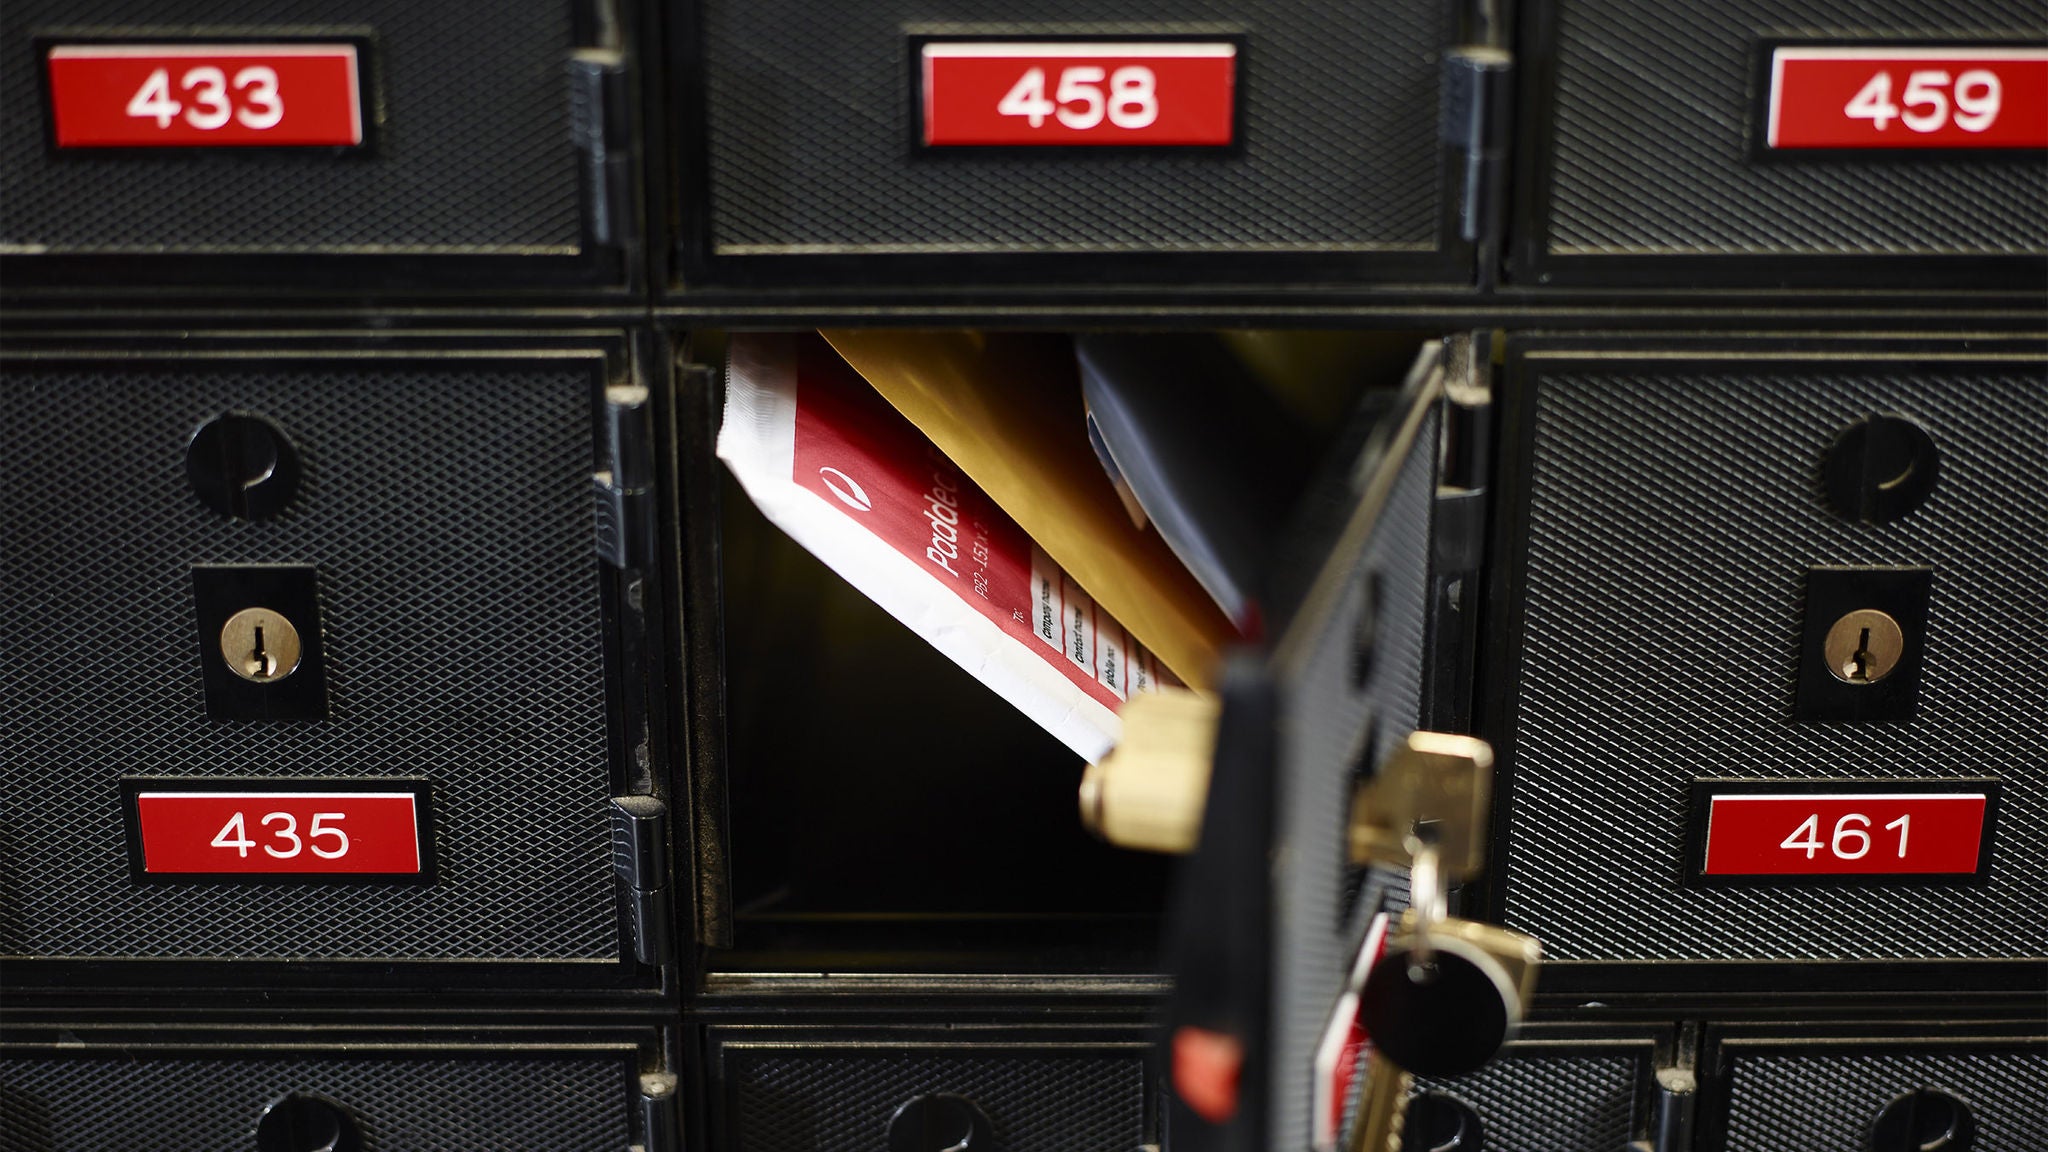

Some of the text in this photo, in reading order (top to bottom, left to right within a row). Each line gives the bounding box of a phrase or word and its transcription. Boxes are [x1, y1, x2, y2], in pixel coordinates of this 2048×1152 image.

[126, 66, 284, 130] 433
[997, 66, 1158, 130] 458
[1844, 71, 2001, 133] 459
[972, 540, 988, 569] 151
[974, 571, 989, 600] PB2
[1042, 603, 1053, 639] Company
[1073, 630, 1084, 664] Contact
[211, 811, 350, 860] 435
[1779, 813, 1910, 860] 461
